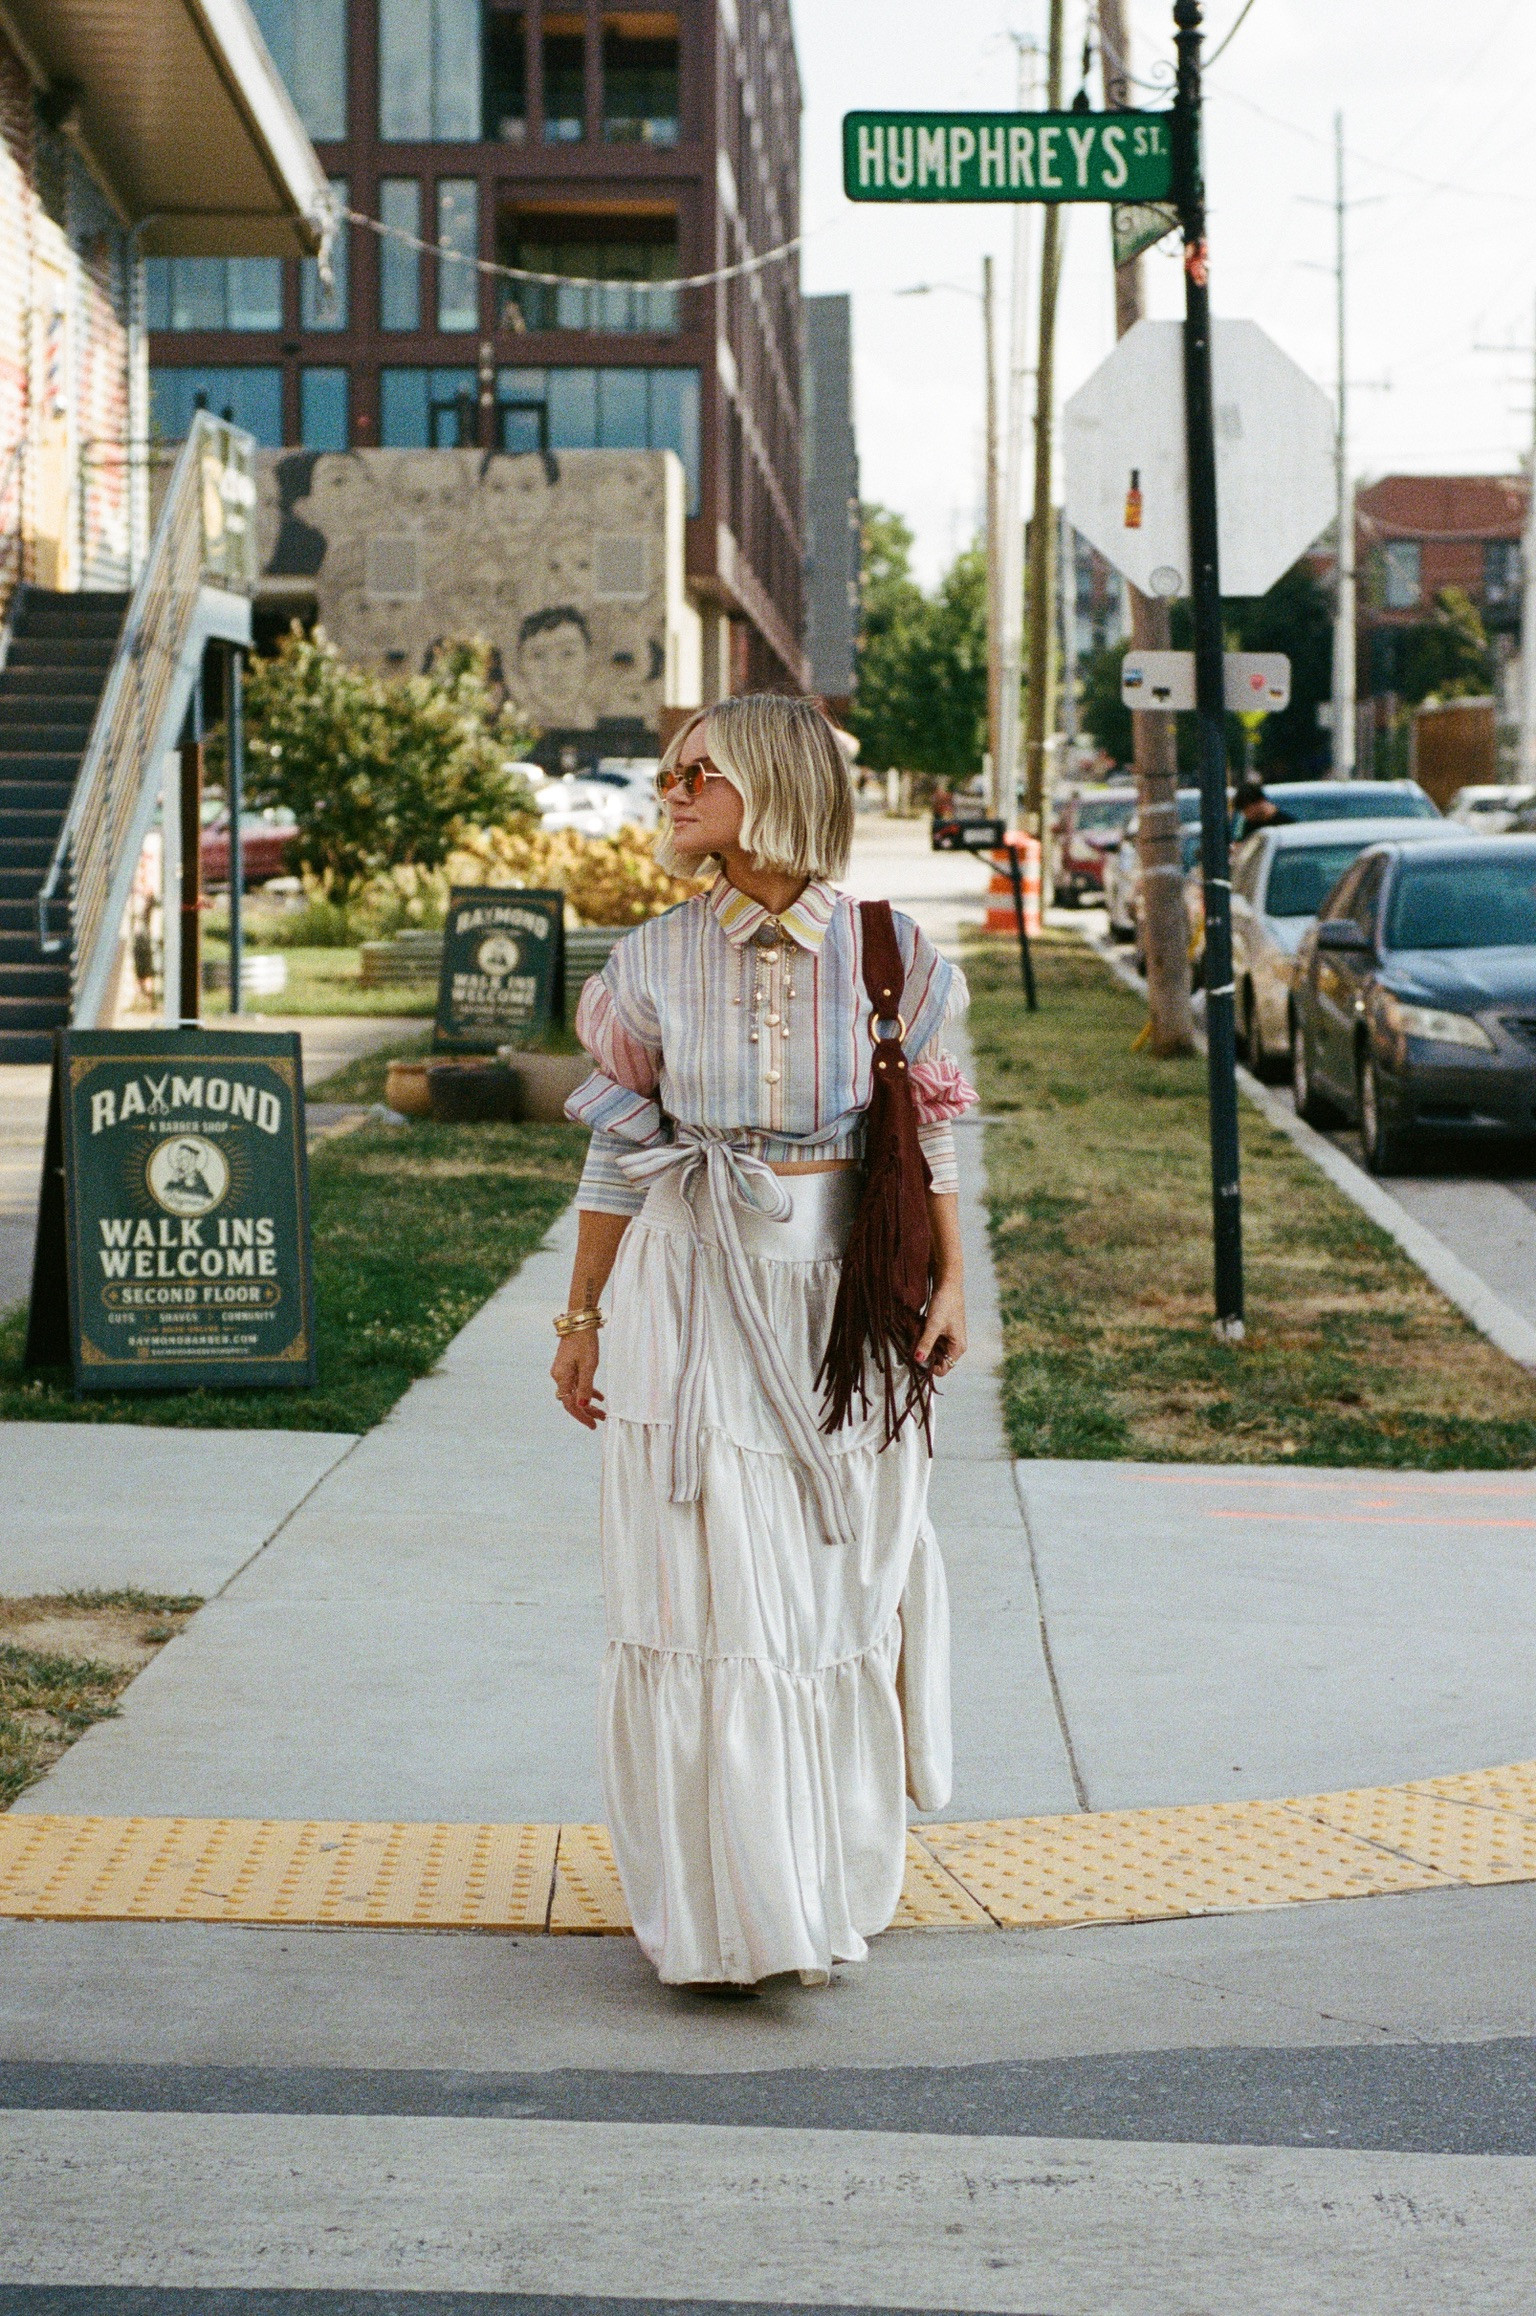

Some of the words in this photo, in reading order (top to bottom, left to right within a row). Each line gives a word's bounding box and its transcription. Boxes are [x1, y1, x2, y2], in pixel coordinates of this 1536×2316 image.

[858, 125, 1129, 189] HUMPHREYS
[1134, 126, 1168, 155] ST.
[149, 1121, 156, 1132] A
[99, 1219, 204, 1248] WALK
[219, 1218, 275, 1247] INS
[99, 1248, 277, 1278] WELCOME
[122, 1287, 196, 1304] SECOND
[203, 1286, 261, 1303] FLOOR
